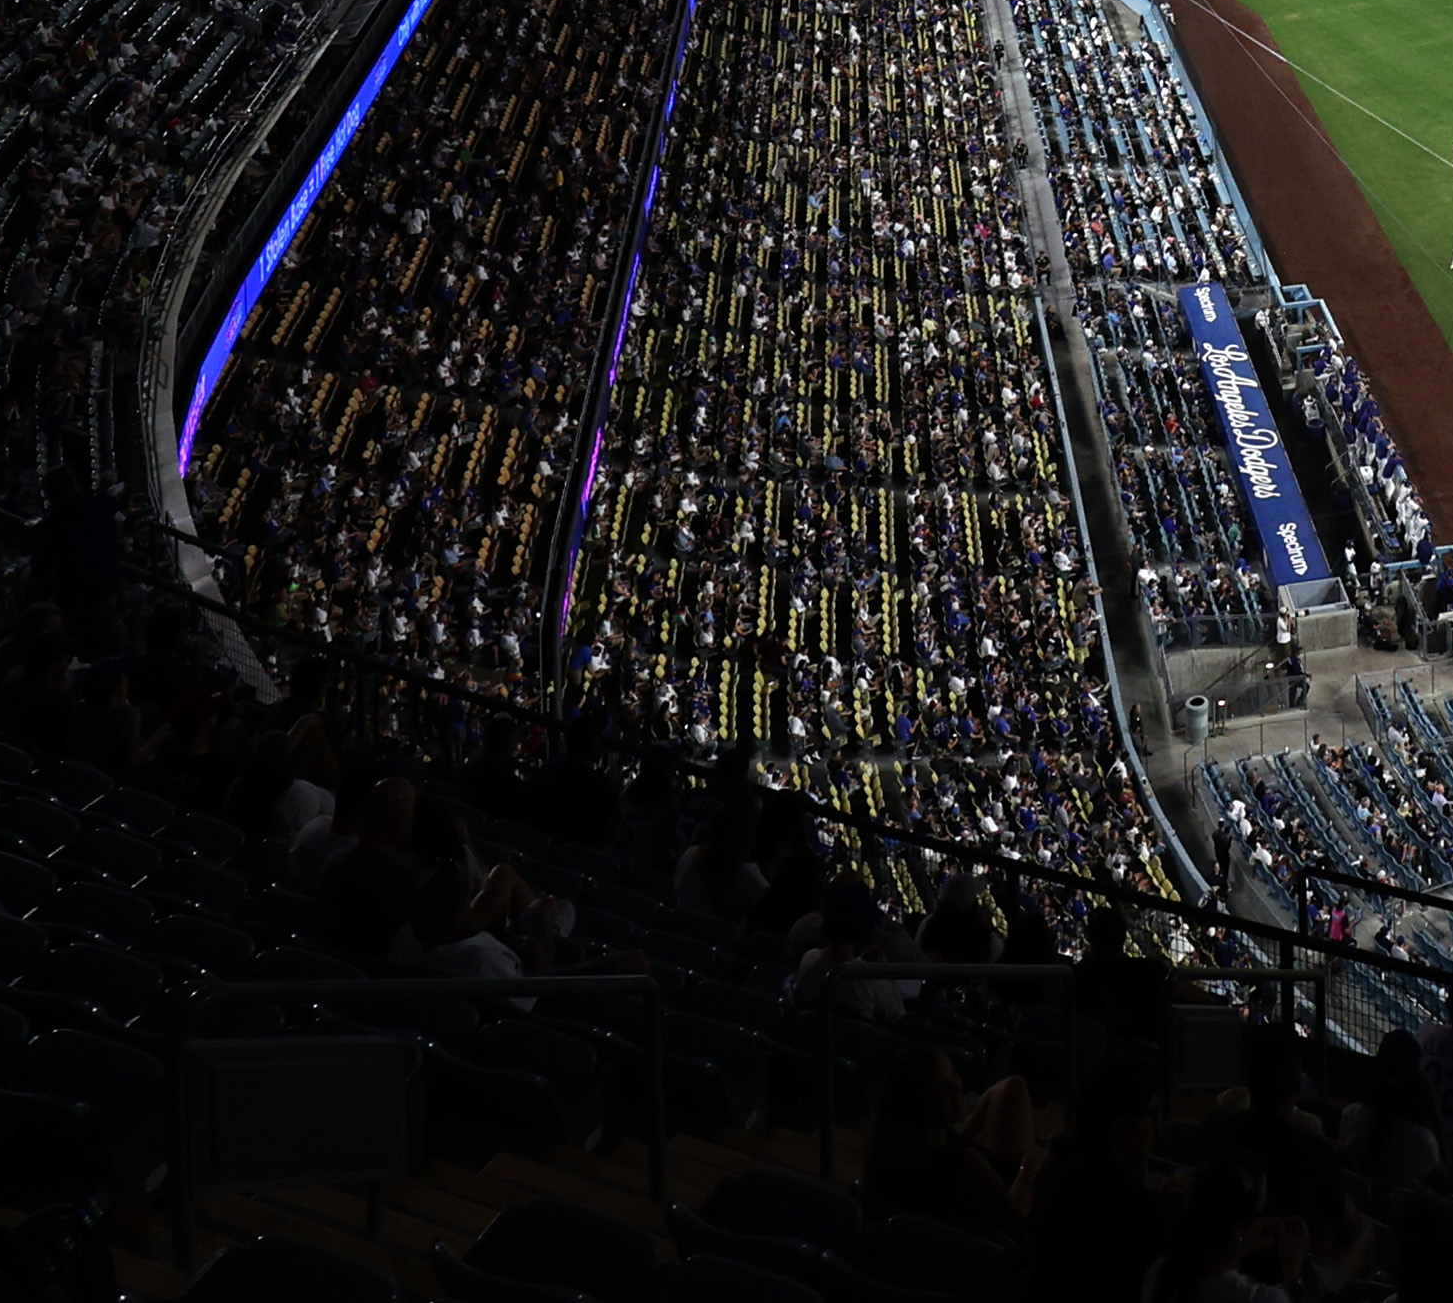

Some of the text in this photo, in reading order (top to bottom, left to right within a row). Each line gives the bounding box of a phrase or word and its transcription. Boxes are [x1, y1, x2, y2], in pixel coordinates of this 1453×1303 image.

[1195, 285, 1217, 323] Spectrum
[1203, 342, 1280, 499] Los Angeles Dodgers
[1279, 522, 1308, 577] Spectrum
